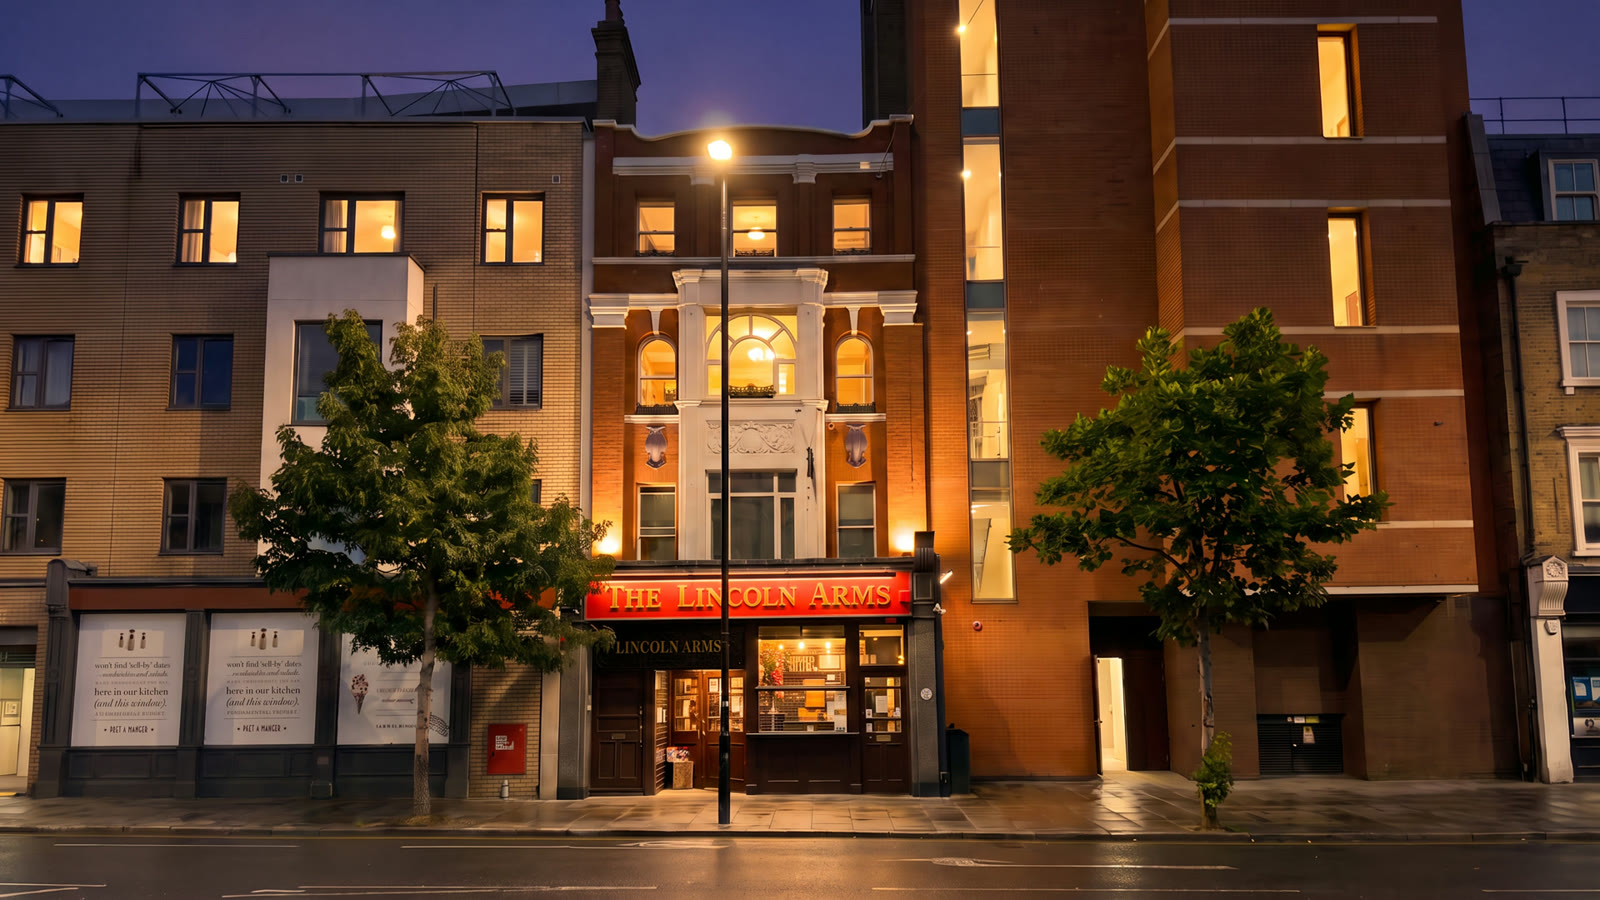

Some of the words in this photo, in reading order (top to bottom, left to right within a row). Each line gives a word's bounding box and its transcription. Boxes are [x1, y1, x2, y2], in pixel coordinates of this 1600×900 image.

[604, 585, 662, 609] THE
[677, 584, 797, 608] LINCOLN
[809, 582, 891, 606] ARMS
[616, 640, 679, 654] LINCOLN
[681, 639, 722, 653] ARMS
[94, 688, 112, 696] here
[114, 688, 122, 696] in
[139, 687, 169, 696] kitchen
[226, 686, 244, 695] here
[245, 686, 254, 694] in
[271, 686, 301, 694] kitchen
[94, 699, 114, 709] (and
[114, 699, 129, 707] this
[130, 699, 167, 709] window).
[226, 697, 246, 708] (and
[246, 697, 261, 706] this
[262, 697, 300, 707] window).
